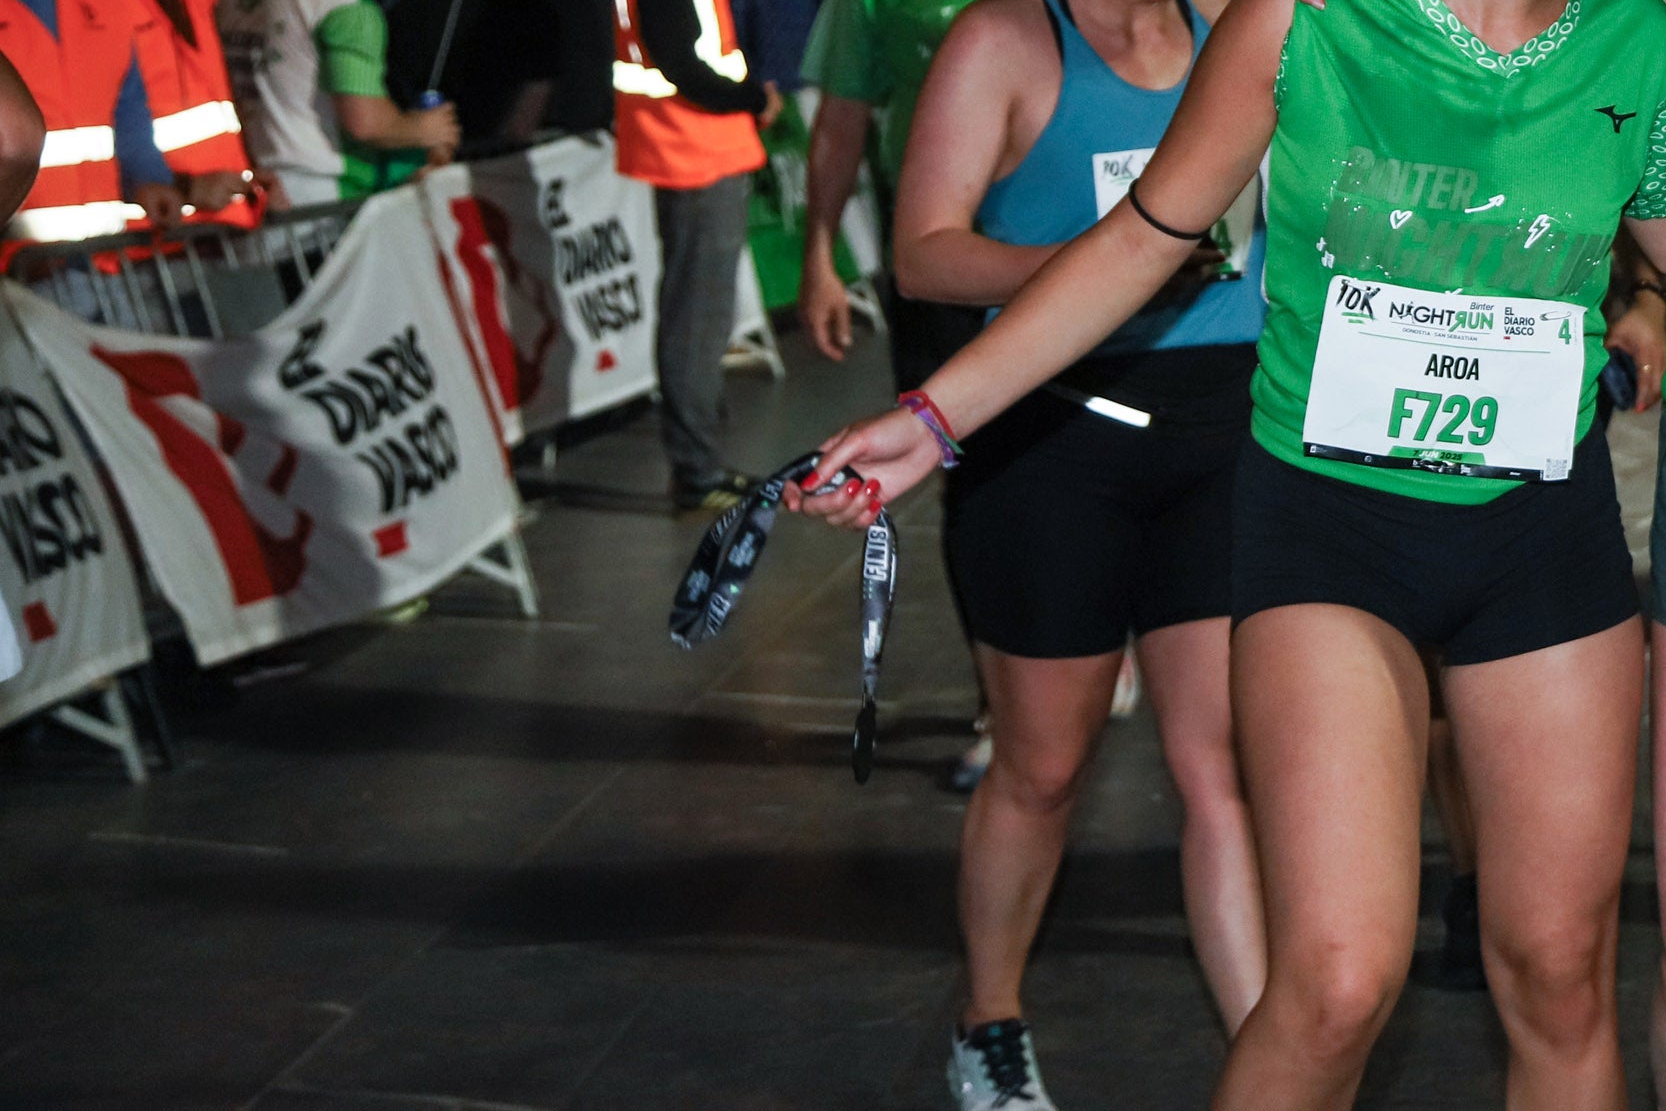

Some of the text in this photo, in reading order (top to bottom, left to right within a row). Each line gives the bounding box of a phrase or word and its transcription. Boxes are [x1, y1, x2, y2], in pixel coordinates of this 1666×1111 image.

[1335, 145, 1480, 212] BINTER
[1334, 278, 1382, 321] 10K
[1469, 302, 1495, 312] Binter
[1504, 307, 1515, 316] EL
[1504, 316, 1535, 327] DIARIO
[1504, 326, 1535, 336] VASCO
[1558, 318, 1573, 345] 4
[1424, 353, 1480, 381] AROA
[1387, 387, 1499, 446] F729
[1419, 450, 1439, 459] JUN
[1440, 451, 1463, 461] 2025
